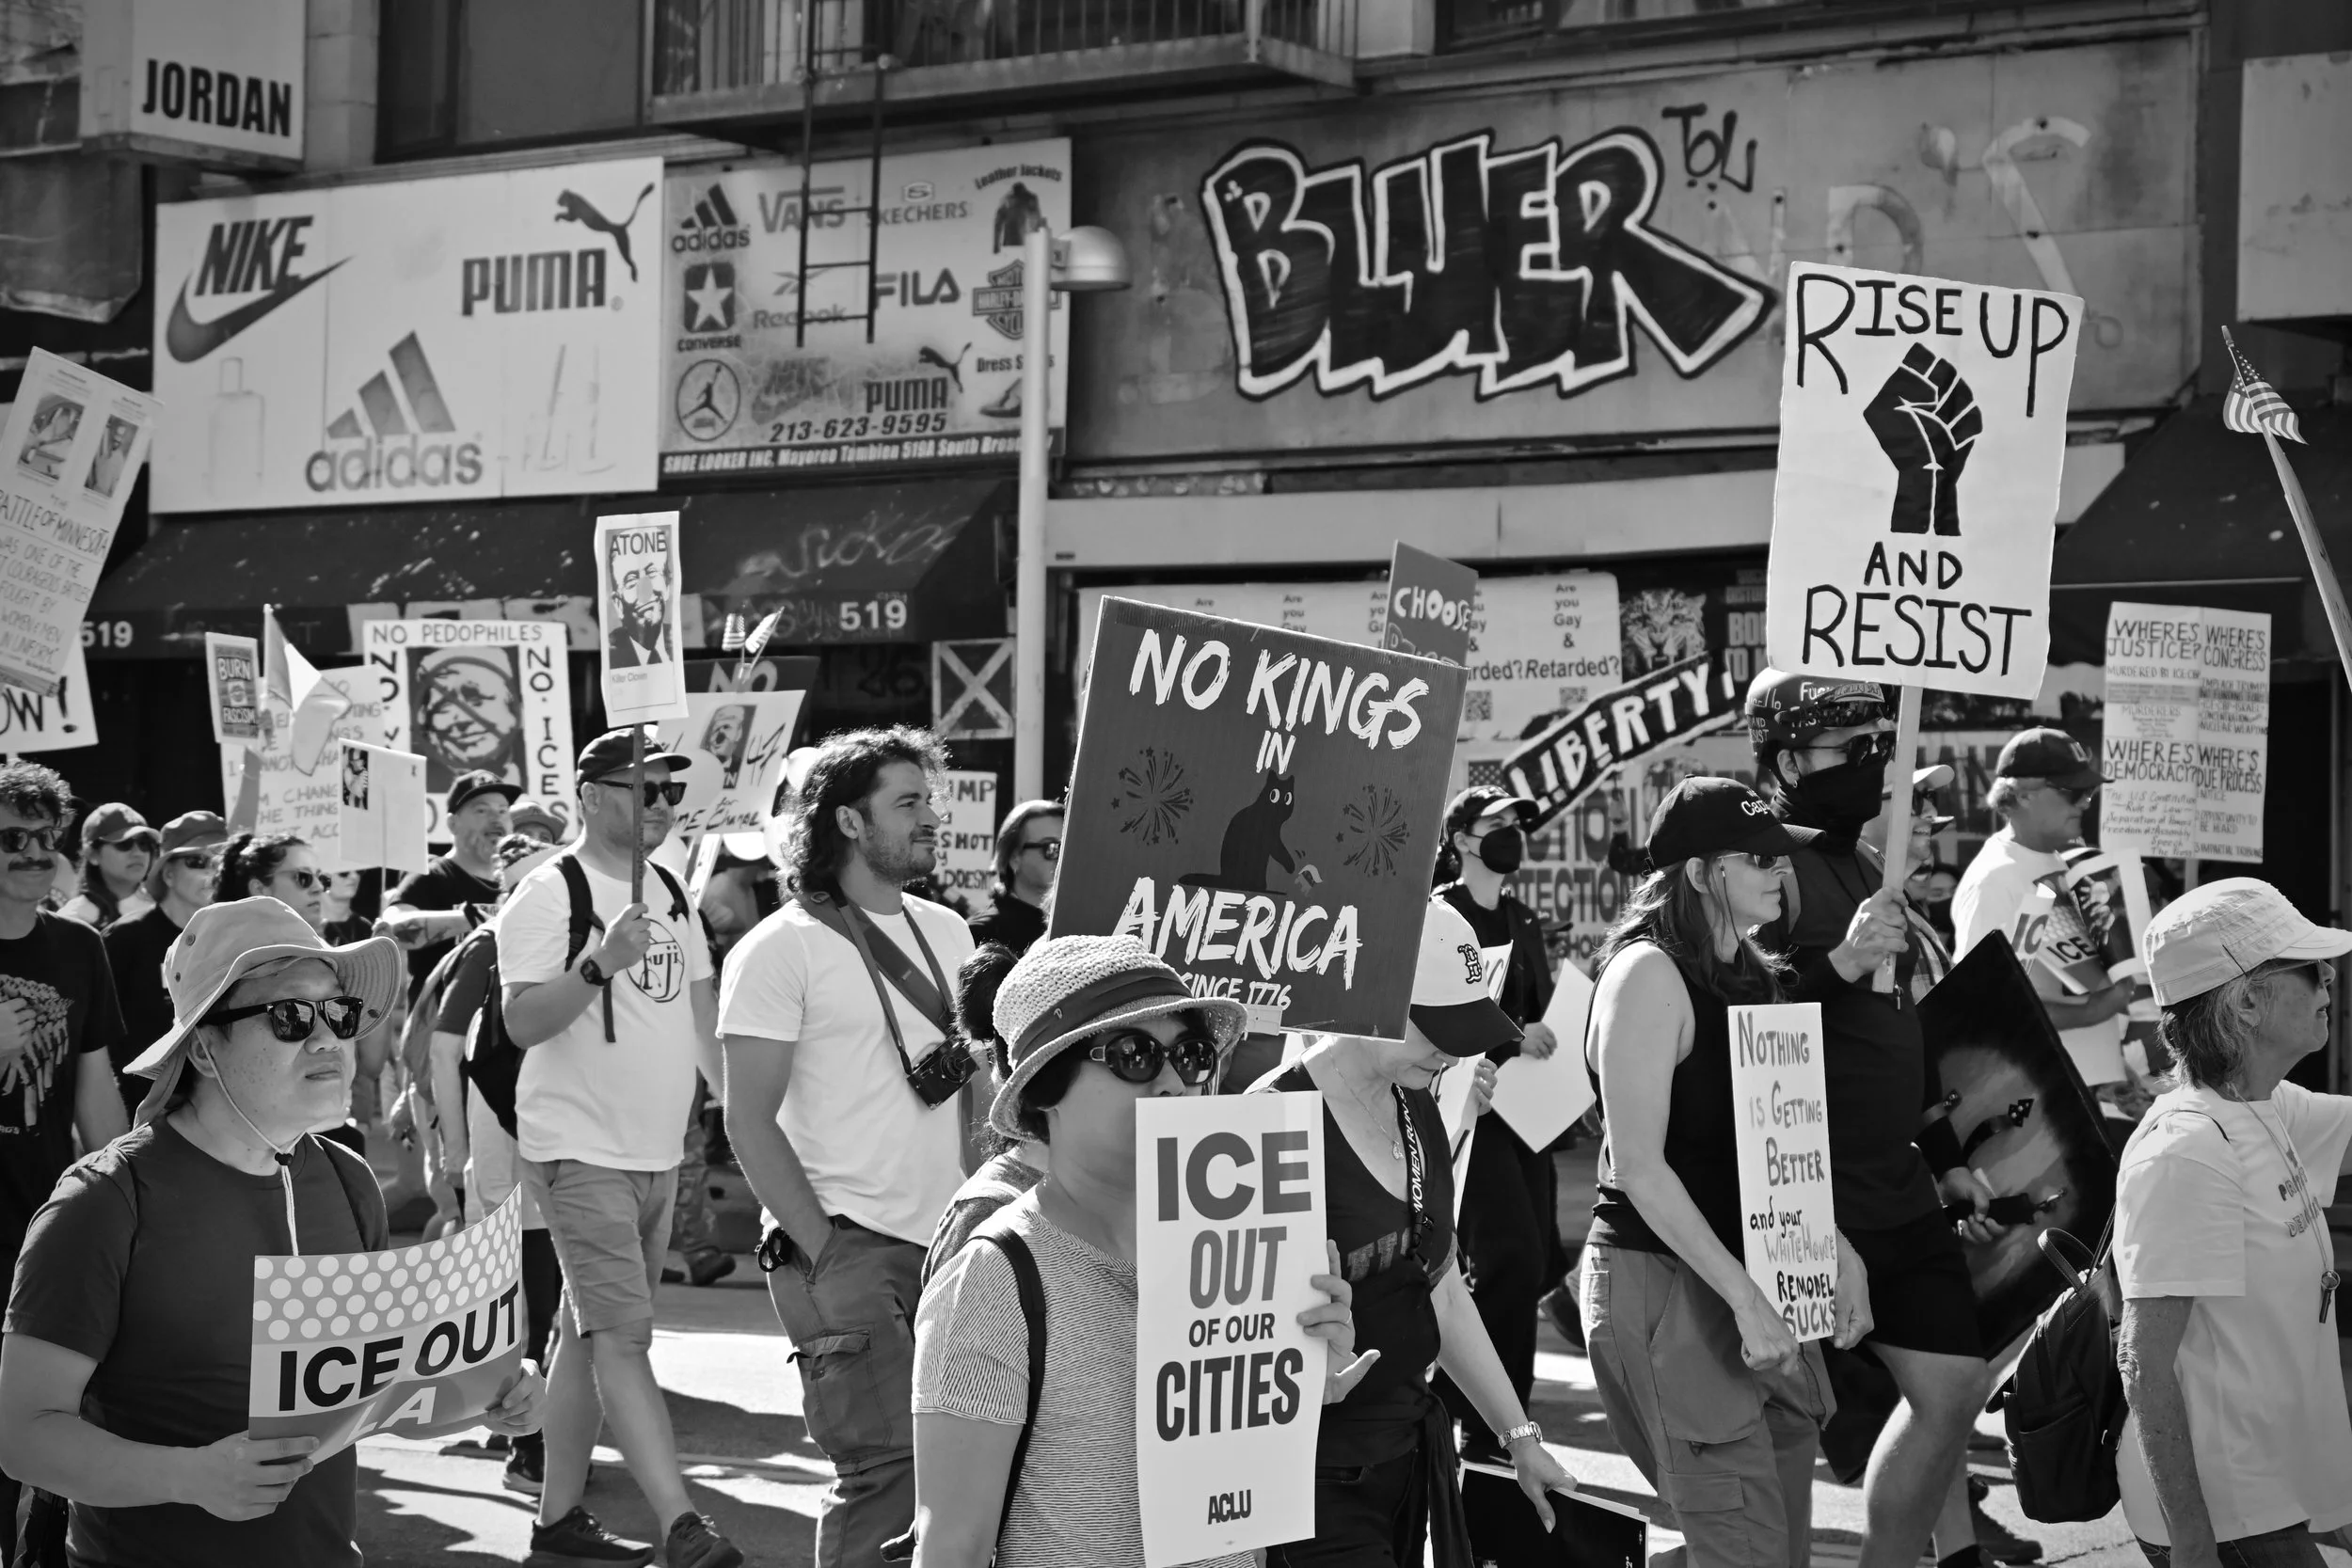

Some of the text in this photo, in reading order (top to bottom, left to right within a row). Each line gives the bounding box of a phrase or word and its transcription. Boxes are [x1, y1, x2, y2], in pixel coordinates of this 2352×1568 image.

[142, 59, 292, 137] JORDAN
[194, 215, 313, 297] NIKE
[672, 228, 751, 253] adidas
[462, 248, 607, 316] PUMA
[875, 267, 961, 311] FILA
[1797, 274, 2069, 418] RISE UP
[977, 356, 1012, 373] Dress
[866, 377, 947, 414] PUMA
[769, 412, 948, 443] 213-623-9595
[305, 434, 483, 493] adidas
[609, 531, 667, 557] ATONE
[1864, 541, 1963, 590] AND
[1283, 594, 1303, 604] Are
[1555, 583, 1577, 594] Are
[1555, 597, 1580, 610] you
[838, 597, 908, 632] 519
[1282, 609, 1305, 620] you
[1393, 586, 1472, 631] CHOOSE
[1553, 613, 1582, 631] Gay
[81, 621, 133, 648] 519
[373, 624, 543, 643] NO PEDOPHILES
[1803, 583, 2033, 676] RESIST
[2115, 619, 2201, 641] WHERE'S
[2206, 625, 2265, 650] WHERE'S
[2107, 638, 2201, 659] JUSTICE?
[2204, 646, 2267, 673] CONGRESS
[217, 657, 251, 681] BURN
[1525, 657, 1621, 681] Retarded?
[1129, 629, 1430, 750] NO KINGS
[223, 706, 256, 724] FASCISM
[1256, 730, 1296, 774] IN
[1509, 662, 1711, 809] LIBERTY
[2106, 739, 2195, 764] WHERE'S
[2103, 761, 2197, 783] DEMOCRACY?
[2198, 744, 2260, 772] WHERE'S
[2197, 767, 2263, 795] DUE PROCESS
[1112, 876, 1363, 990] AMERICA
[2046, 936, 2099, 964] ICE
[1181, 972, 1292, 1010] SINCE 1776
[1771, 1080, 1822, 1129] GETTING
[1157, 1130, 1312, 1222] ICE
[1766, 1137, 1825, 1187] BETTER
[1750, 1195, 1804, 1239] and your
[1189, 1226, 1287, 1310] OUT
[1776, 1271, 1835, 1304] REMODEL
[1188, 1312, 1276, 1348] OF OUR
[1782, 1301, 1836, 1338] SUCKS
[278, 1279, 519, 1412] ICE OUT
[1156, 1347, 1304, 1443] CITIES
[1207, 1489, 1252, 1525] ACLU
